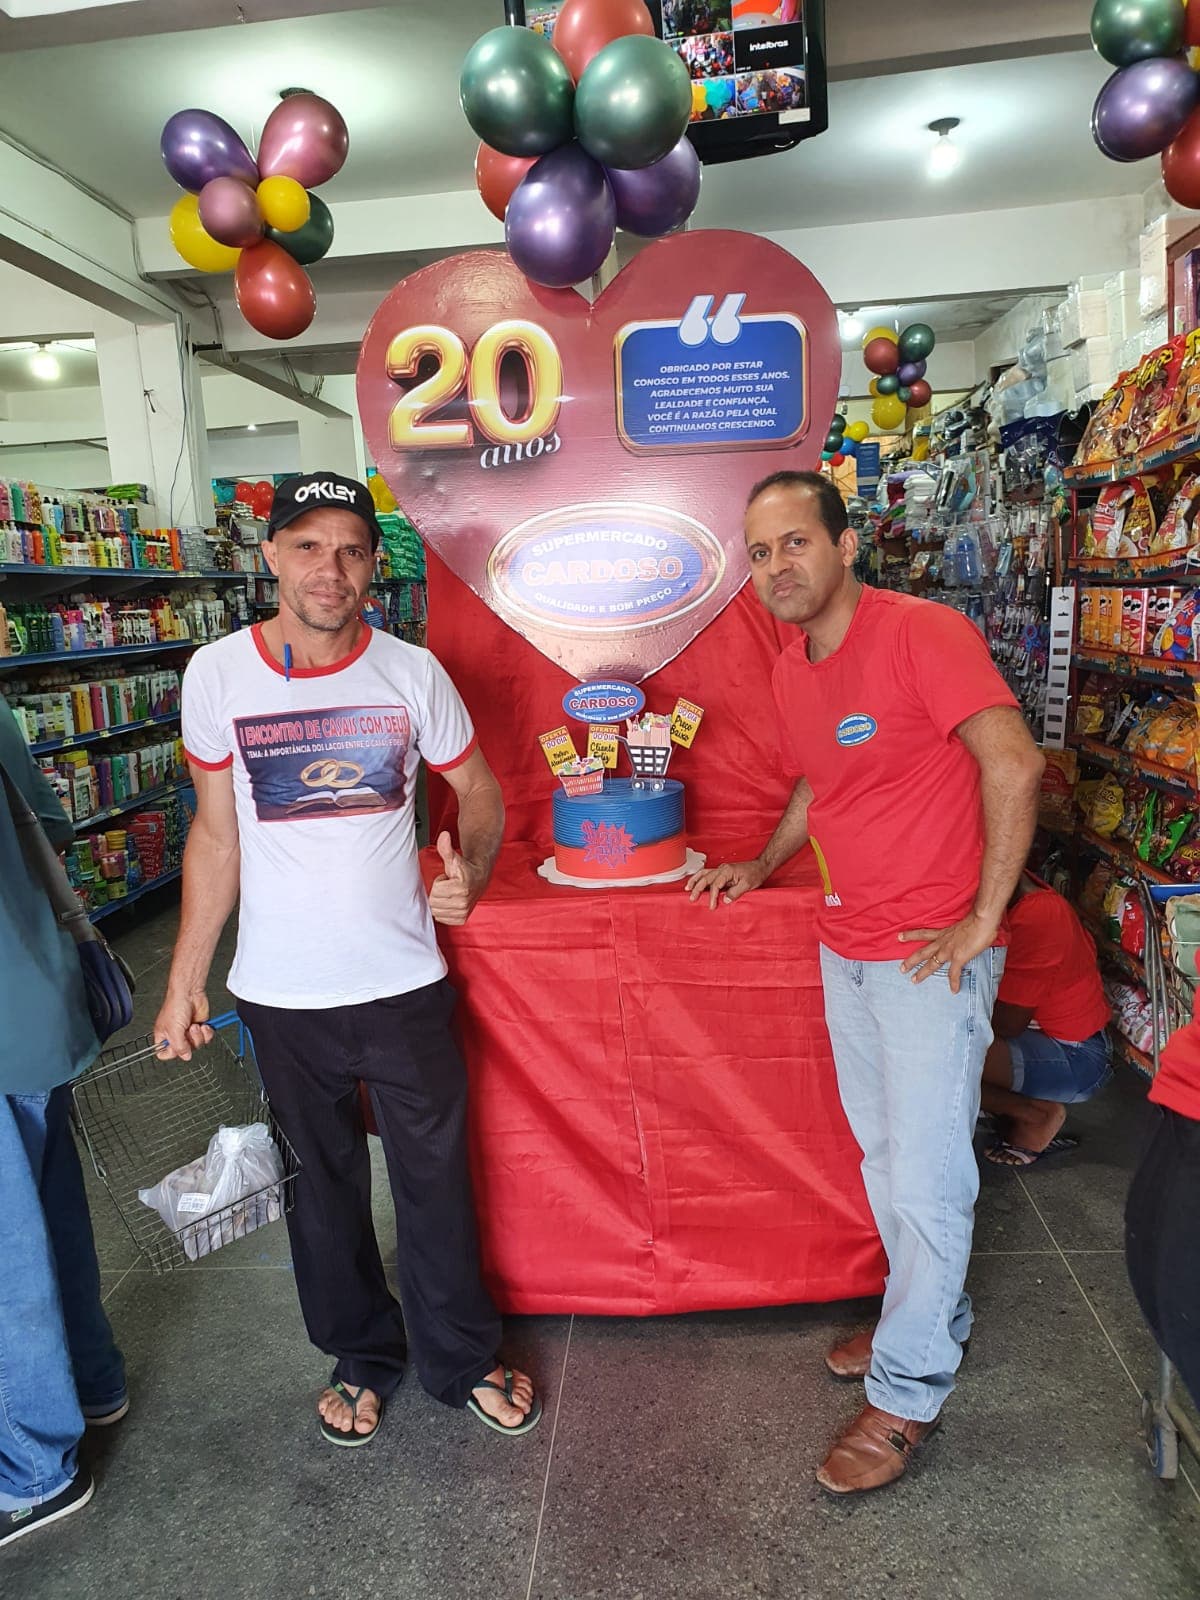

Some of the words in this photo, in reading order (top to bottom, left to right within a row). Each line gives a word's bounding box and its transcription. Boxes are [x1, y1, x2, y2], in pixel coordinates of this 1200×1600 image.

[749, 40, 789, 51] intelbras
[660, 363, 710, 374] OBRIGADO
[711, 362, 732, 372] POR
[733, 360, 763, 370] ESTAR
[386, 319, 564, 452] 20
[633, 377, 679, 387] CONOSCO
[682, 375, 696, 384] EM
[698, 374, 729, 384] TODOS
[731, 372, 759, 382] ESSES
[761, 370, 790, 380] ANOS.
[650, 386, 721, 398] AGRADECEMOS
[723, 385, 753, 394] MUITO
[755, 383, 774, 393] SUA
[655, 399, 704, 409] LEALDADE
[713, 396, 769, 407] CONFIANÇA.
[648, 410, 673, 421] VOCÊ
[675, 410, 681, 420] É
[683, 411, 690, 420] A
[692, 409, 724, 419] RAZÃO
[726, 408, 750, 417] PELA
[752, 407, 777, 417] QUAL
[649, 422, 717, 433] CONTINUAMOS
[718, 419, 776, 430] CRESCENDO.
[480, 432, 561, 469] anos
[294, 481, 356, 504] OAKLEY
[532, 530, 668, 557] SUPERMERCADO
[522, 556, 683, 586] CARDOSO
[535, 592, 596, 613] QUALIDADE
[599, 605, 605, 613] E
[609, 602, 634, 613] BOM
[637, 587, 673, 606] PREÇO
[574, 684, 632, 697] SUPERMERCADO
[569, 695, 638, 710] CARDOSO
[245, 720, 304, 746] ENCONTRO
[305, 719, 321, 740] DE
[359, 715, 383, 735] COM
[269, 743, 312, 756] IMPORTÂNCIA
